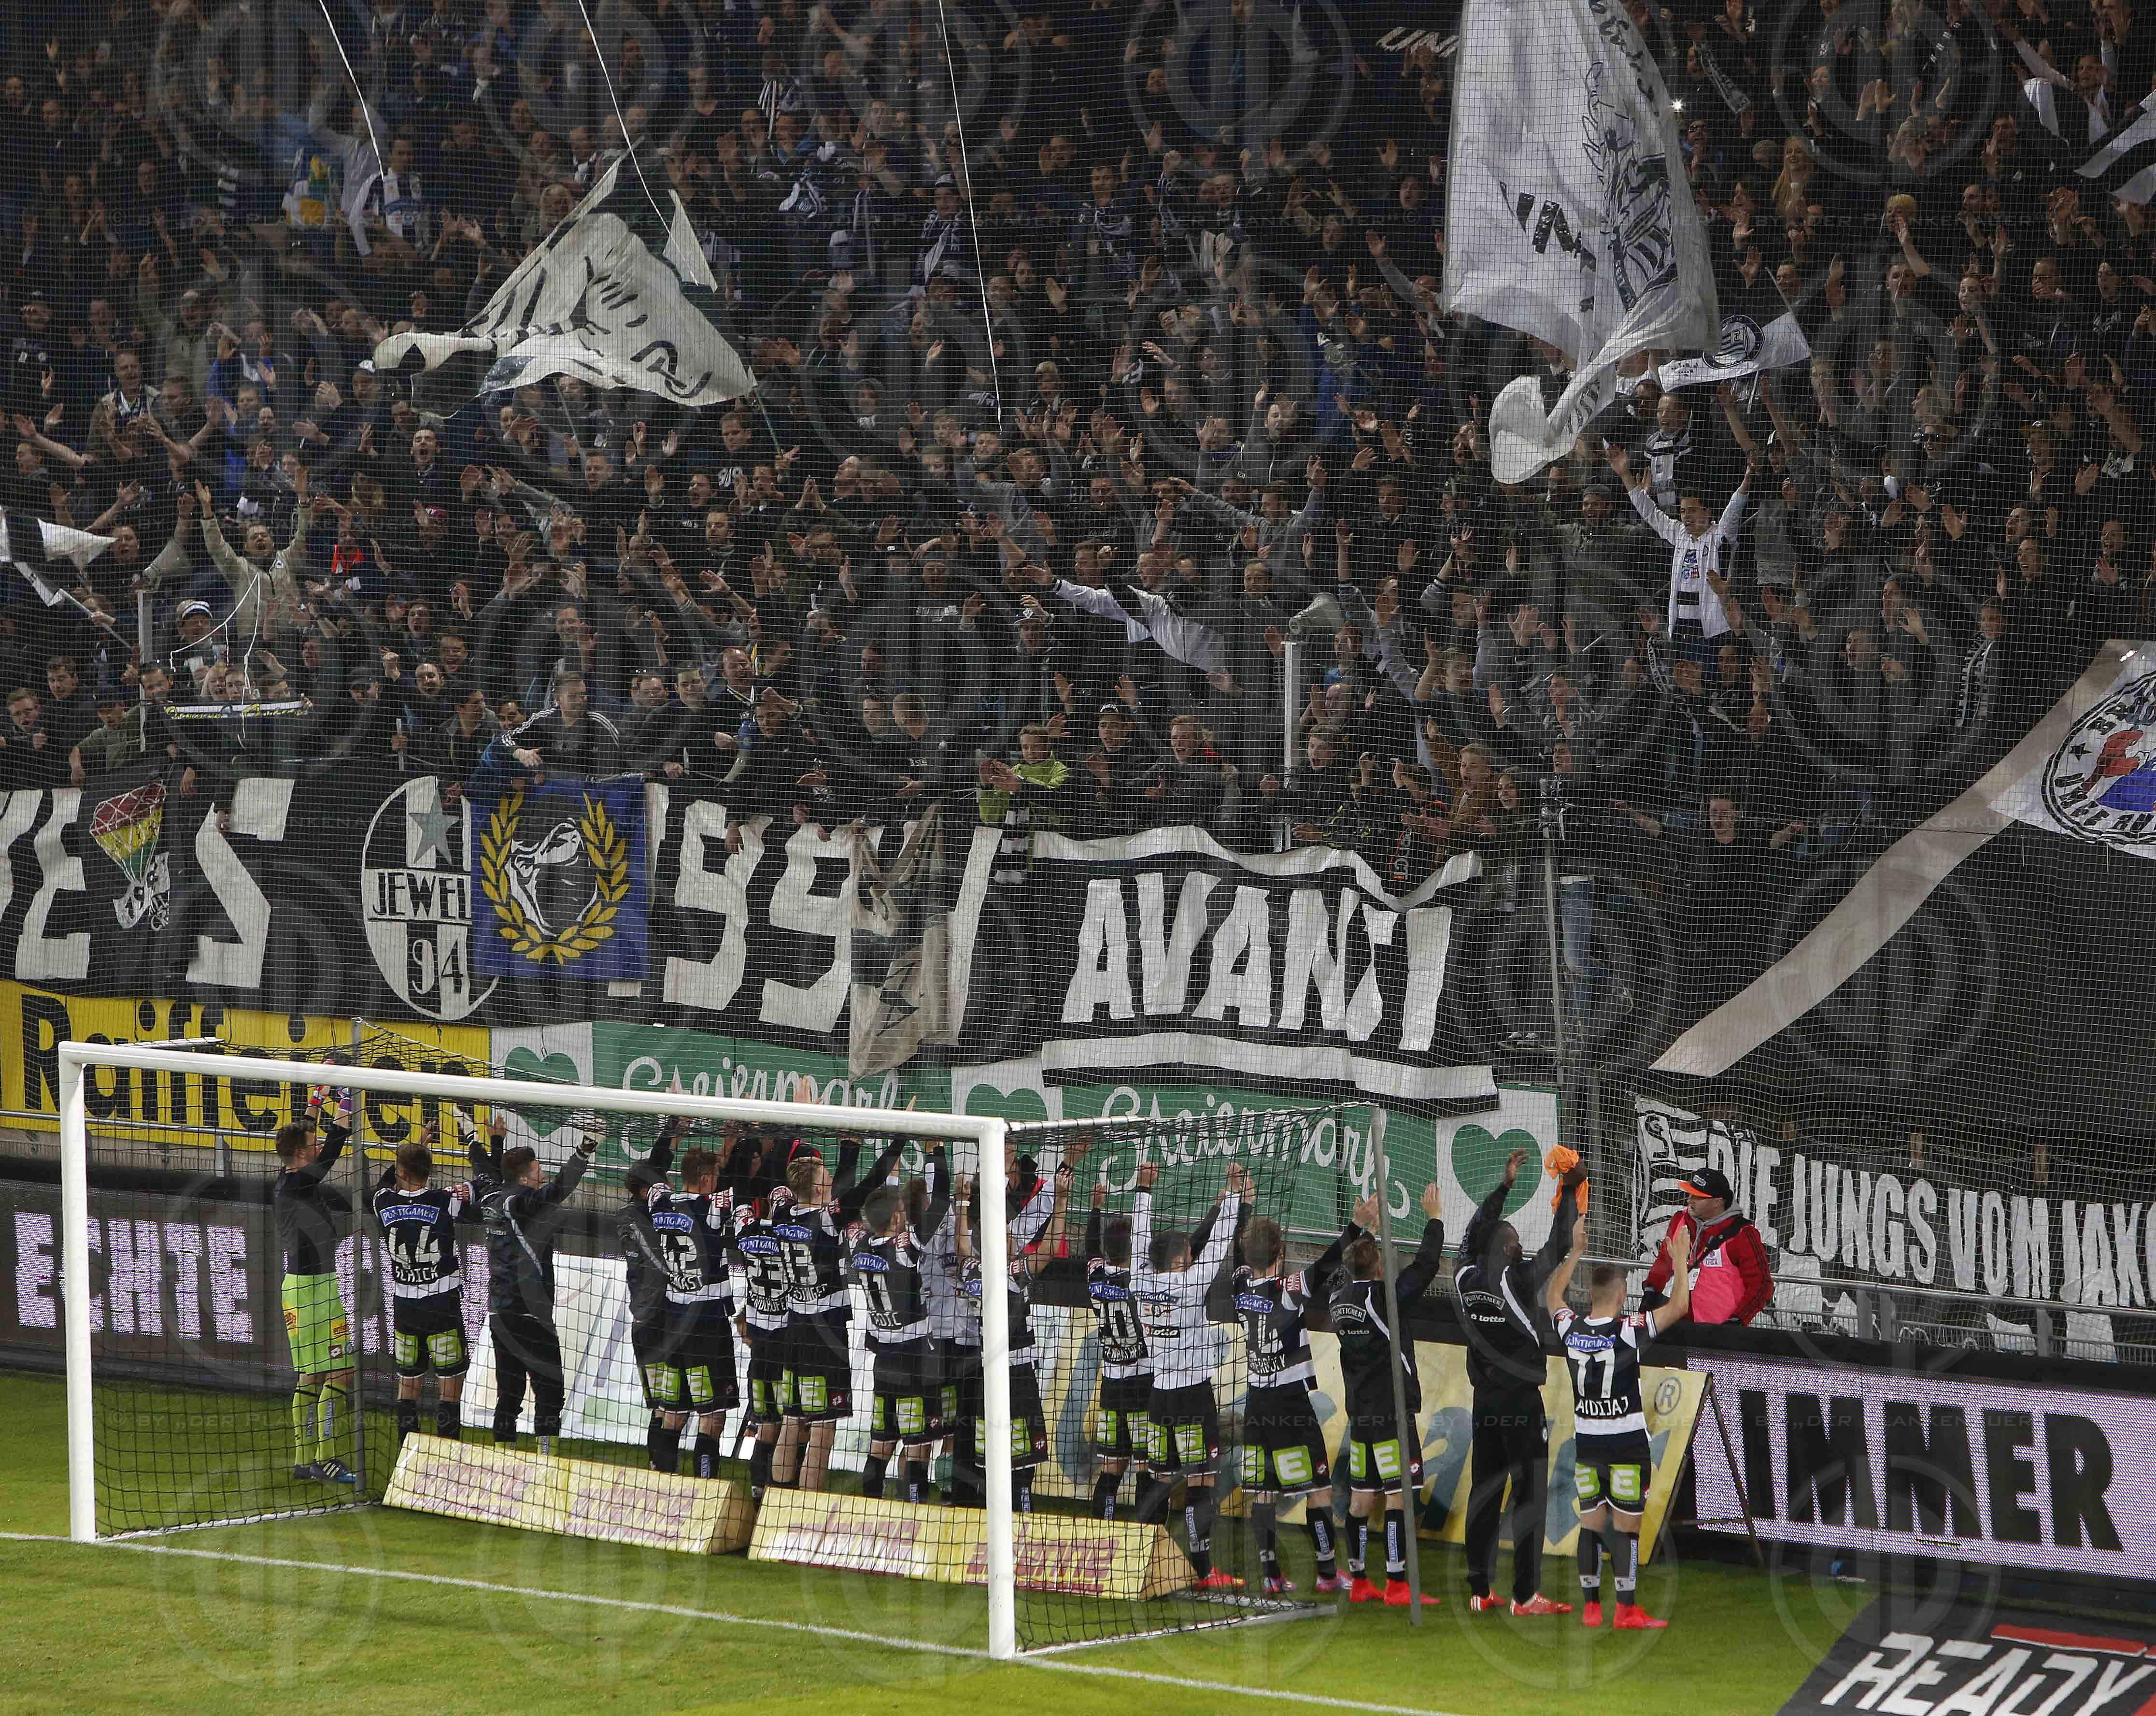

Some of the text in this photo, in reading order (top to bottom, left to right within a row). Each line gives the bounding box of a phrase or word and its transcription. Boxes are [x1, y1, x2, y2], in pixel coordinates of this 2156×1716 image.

[411, 937, 464, 995] 94
[1063, 872, 1453, 1052] AVANTI
[1789, 1153, 1938, 1285] JUNGS
[1948, 1187, 2051, 1300] VOM
[1479, 1315, 1506, 1323] lotto
[1568, 1348, 1616, 1399] 77
[1739, 1388, 2124, 1553] IMMER
[1819, 1631, 2156, 1716] READY
